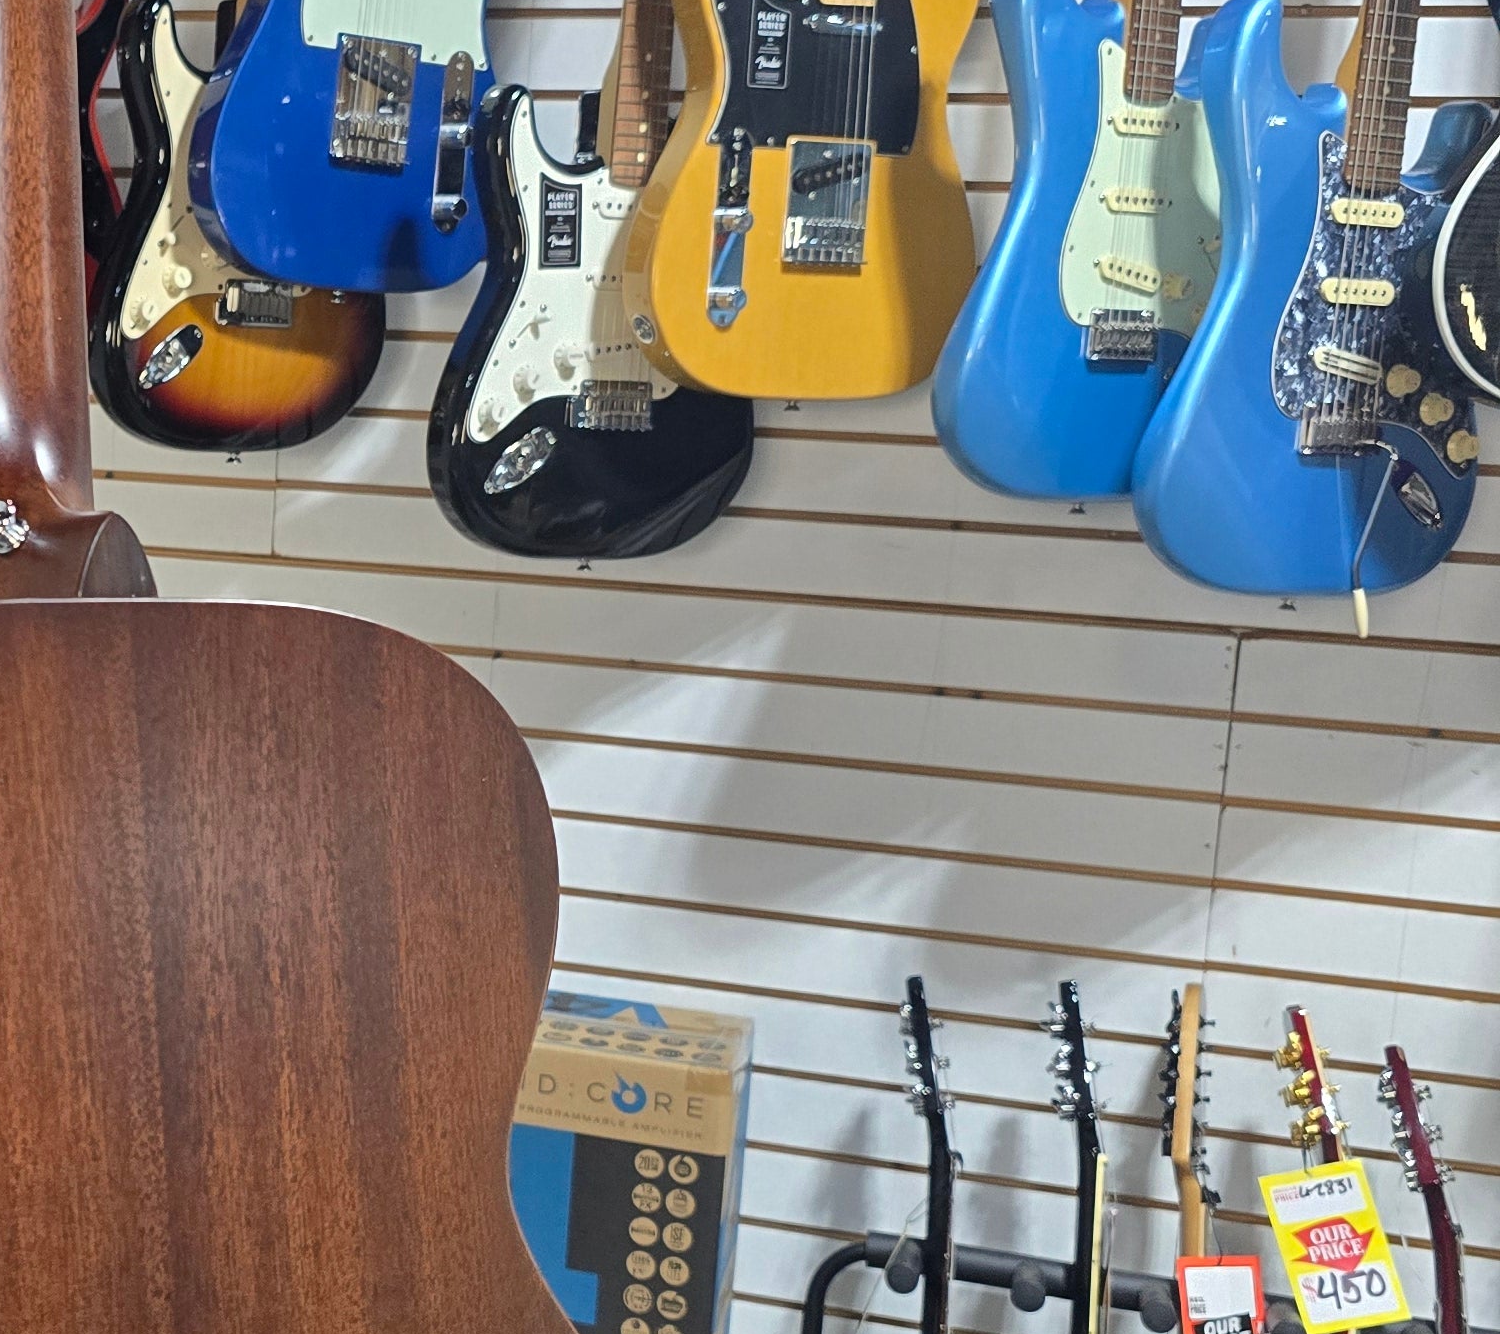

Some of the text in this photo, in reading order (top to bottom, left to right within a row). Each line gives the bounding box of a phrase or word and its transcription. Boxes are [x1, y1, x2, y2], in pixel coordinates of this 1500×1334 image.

[519, 1103, 703, 1140] PROGRAMMABLE AMPLIFIER
[1308, 1237, 1365, 1264] PRICE
[1309, 1223, 1353, 1246] OUR
[1301, 1267, 1386, 1310] $450
